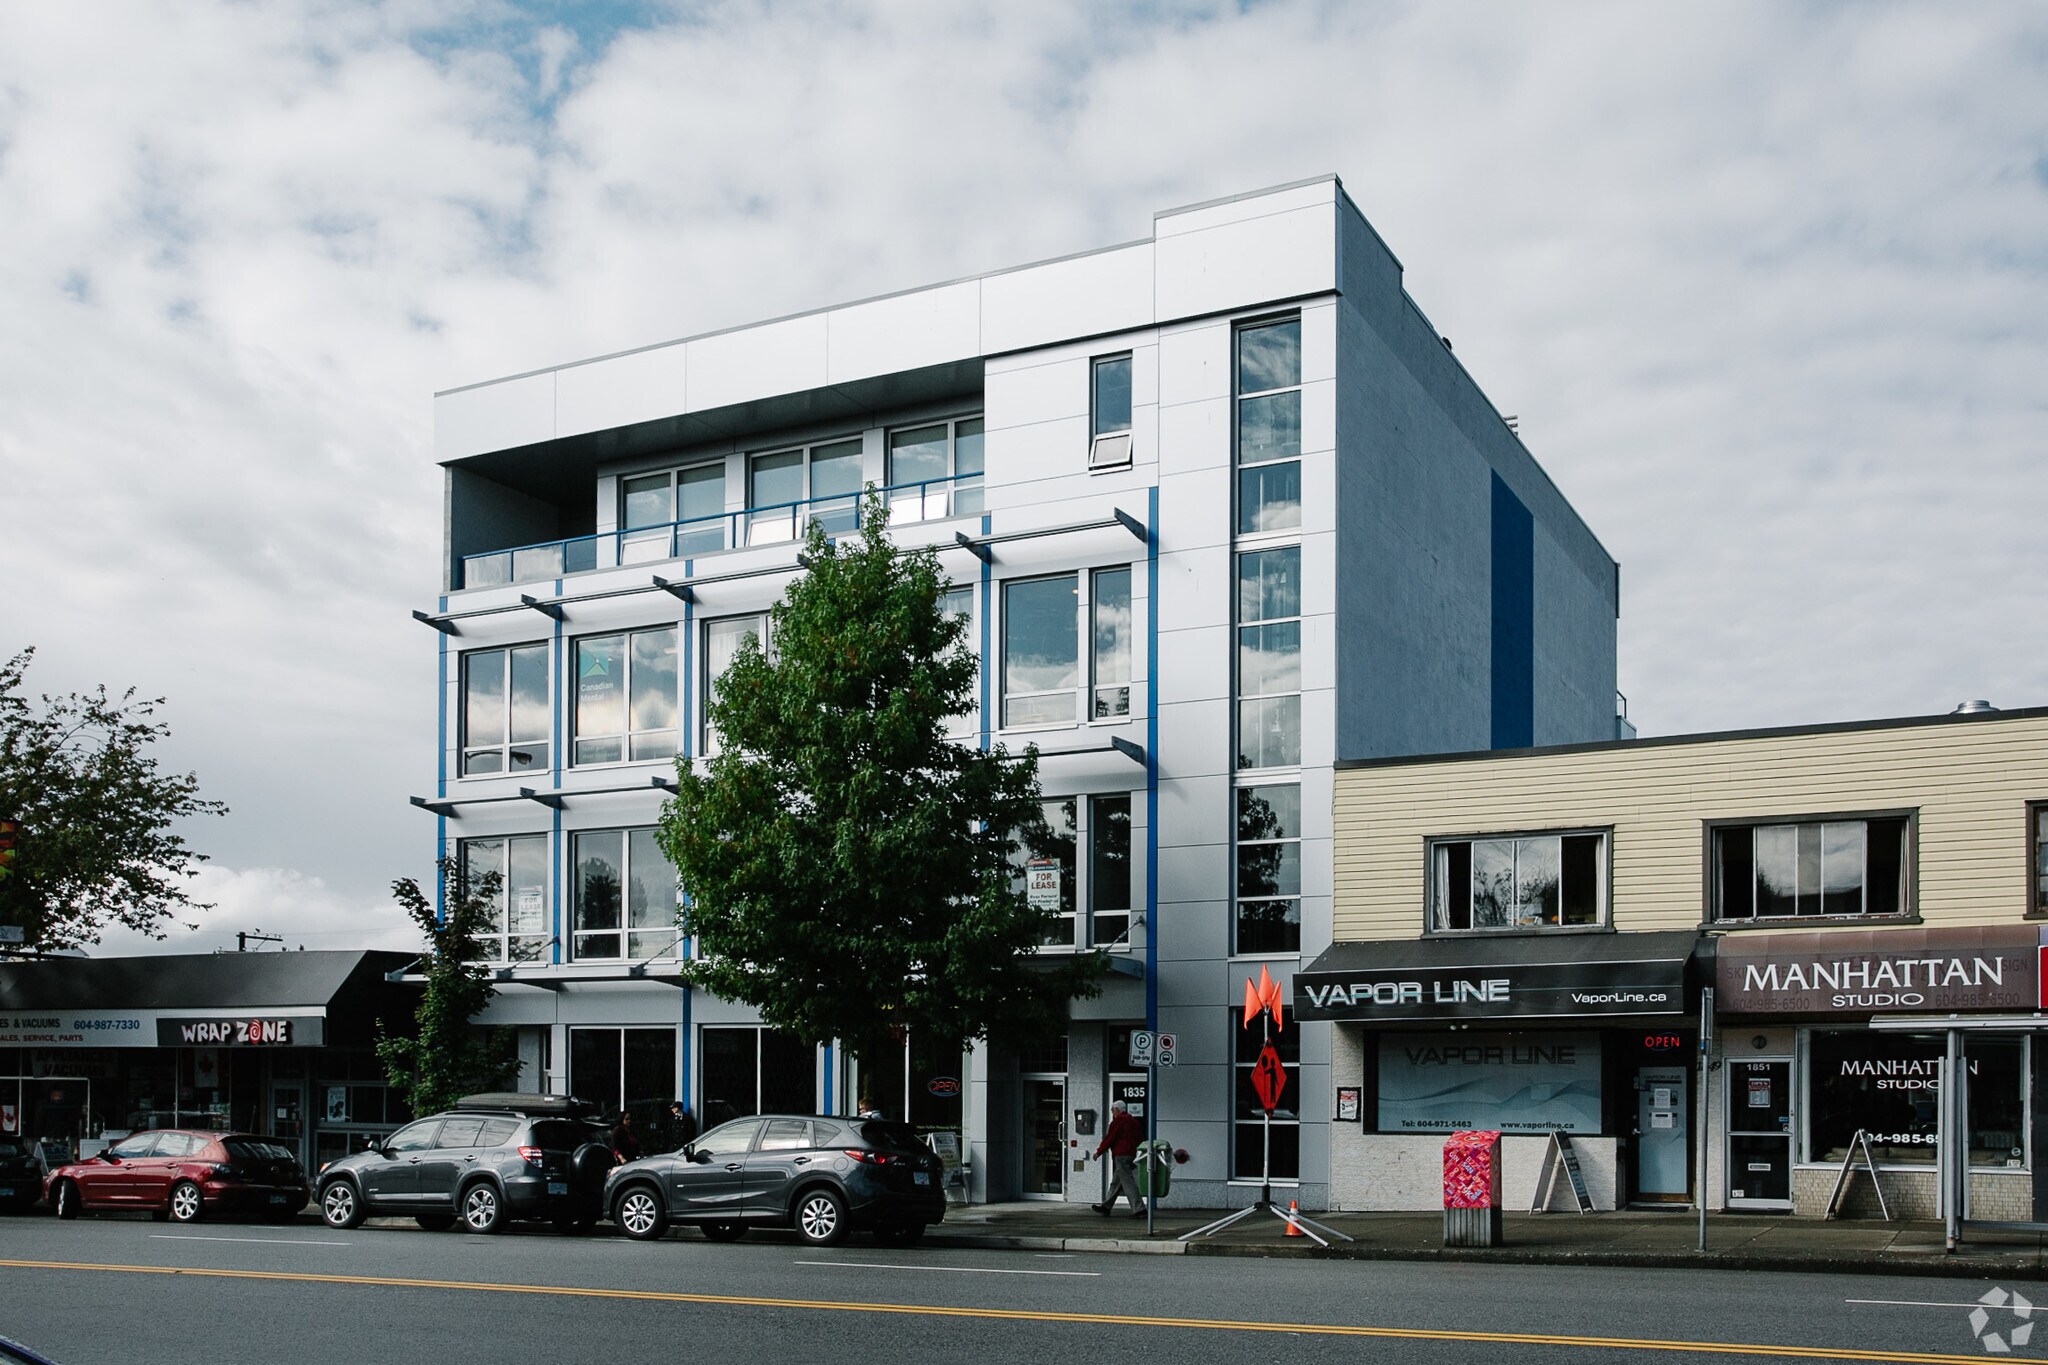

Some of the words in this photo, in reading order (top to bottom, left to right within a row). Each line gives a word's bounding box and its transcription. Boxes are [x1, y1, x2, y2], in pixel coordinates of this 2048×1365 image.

[580, 682, 614, 691] Canadian
[1036, 873, 1052, 881] FOR
[1031, 882, 1057, 890] LEASE
[1743, 957, 2003, 991] MANHATTAN
[1304, 983, 1422, 1008] VAPOR
[1434, 979, 1510, 1004] LINE
[1572, 993, 1667, 1004] VaporLine.ca
[1832, 993, 1924, 1007] STUDIO
[14, 1018, 20, 1028] &
[22, 1018, 60, 1028] VACUUMS
[74, 1020, 140, 1030] 604-987-7330
[181, 1022, 231, 1043] WRAP
[236, 1019, 288, 1044] ZONE
[23, 1035, 57, 1043] SERVICE,
[1645, 1036, 1680, 1047] OPEN
[1405, 1046, 1504, 1065] VAPOR
[1512, 1046, 1575, 1065] LINE
[1747, 1063, 1770, 1071] 1851
[930, 1081, 960, 1091] OPEN
[1123, 1087, 1145, 1097] 1835
[1417, 1120, 1472, 1128] 604-971-5463
[1500, 1121, 1574, 1129] www.vaporline.ca
